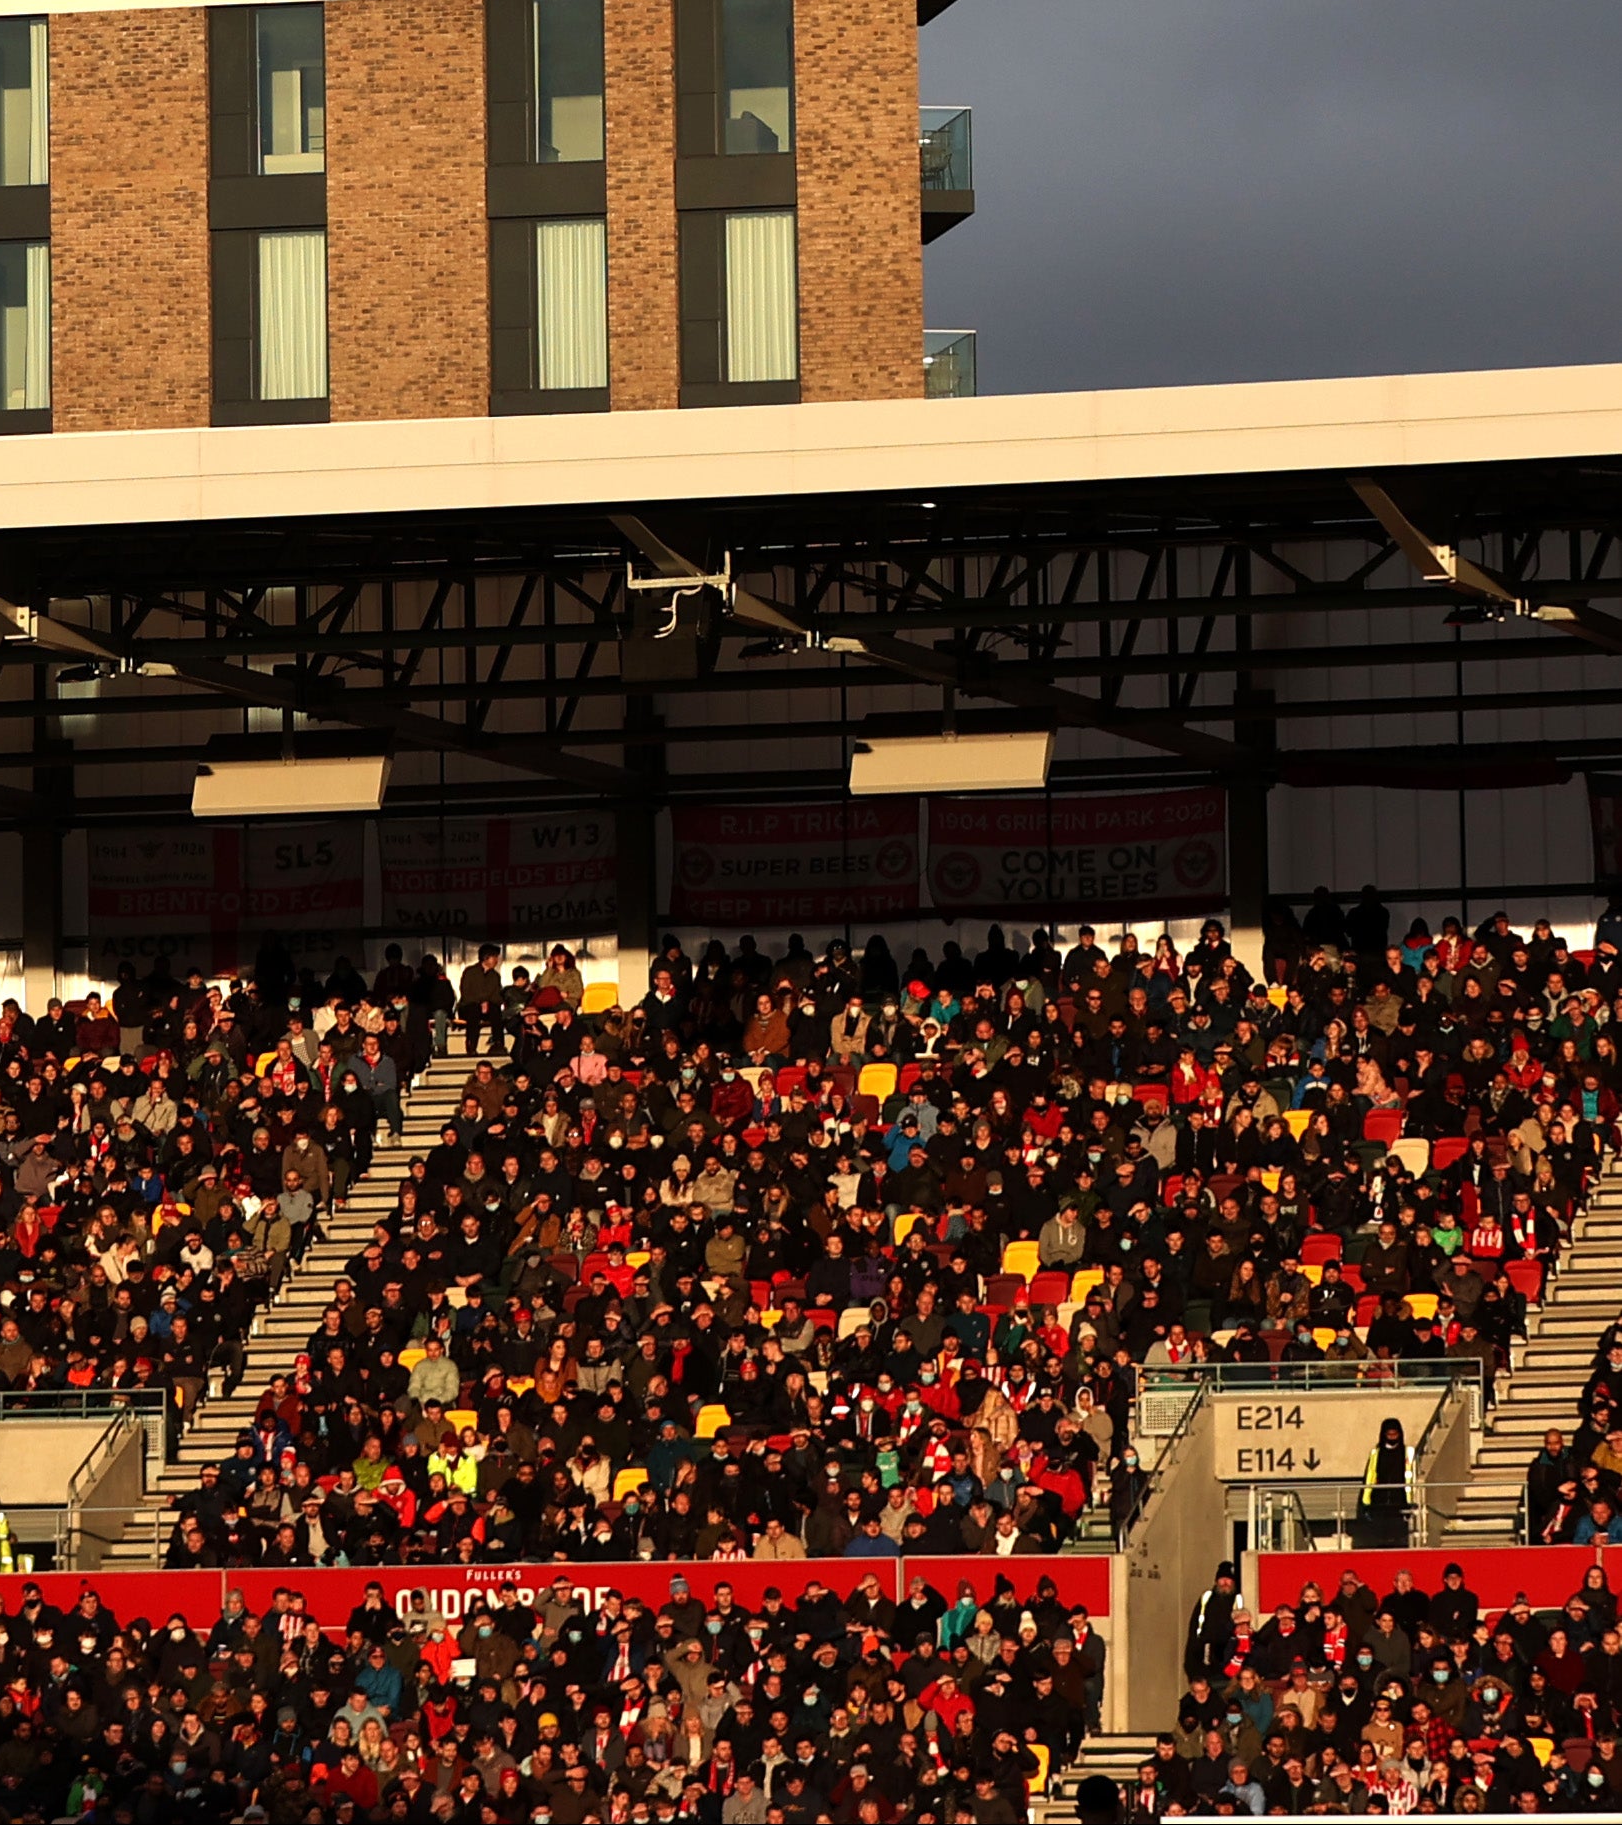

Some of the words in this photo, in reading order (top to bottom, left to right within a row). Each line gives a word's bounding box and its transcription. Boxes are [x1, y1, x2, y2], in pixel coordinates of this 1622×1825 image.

[787, 810, 881, 833] TRICIA
[995, 812, 1086, 832] GRIFFIN
[1094, 809, 1155, 828] PARK
[532, 825, 599, 847] W13
[275, 840, 333, 870] SL5
[721, 859, 800, 876] SUPER
[810, 855, 871, 874] BEES
[1002, 849, 1096, 874] COME
[1108, 846, 1156, 871] ON
[390, 868, 548, 890] NORTHFIELDS
[998, 878, 1065, 900] YOU
[1079, 872, 1158, 898] BEES
[118, 891, 280, 914] BRENTFORD
[396, 909, 469, 927] DAVID
[512, 897, 617, 923] THOMAS
[689, 898, 751, 919] KEEP
[760, 896, 813, 917] THE
[102, 933, 195, 957] ASCOT
[289, 931, 335, 954] EES
[1237, 1405, 1304, 1430] E214
[1237, 1447, 1295, 1472] E114
